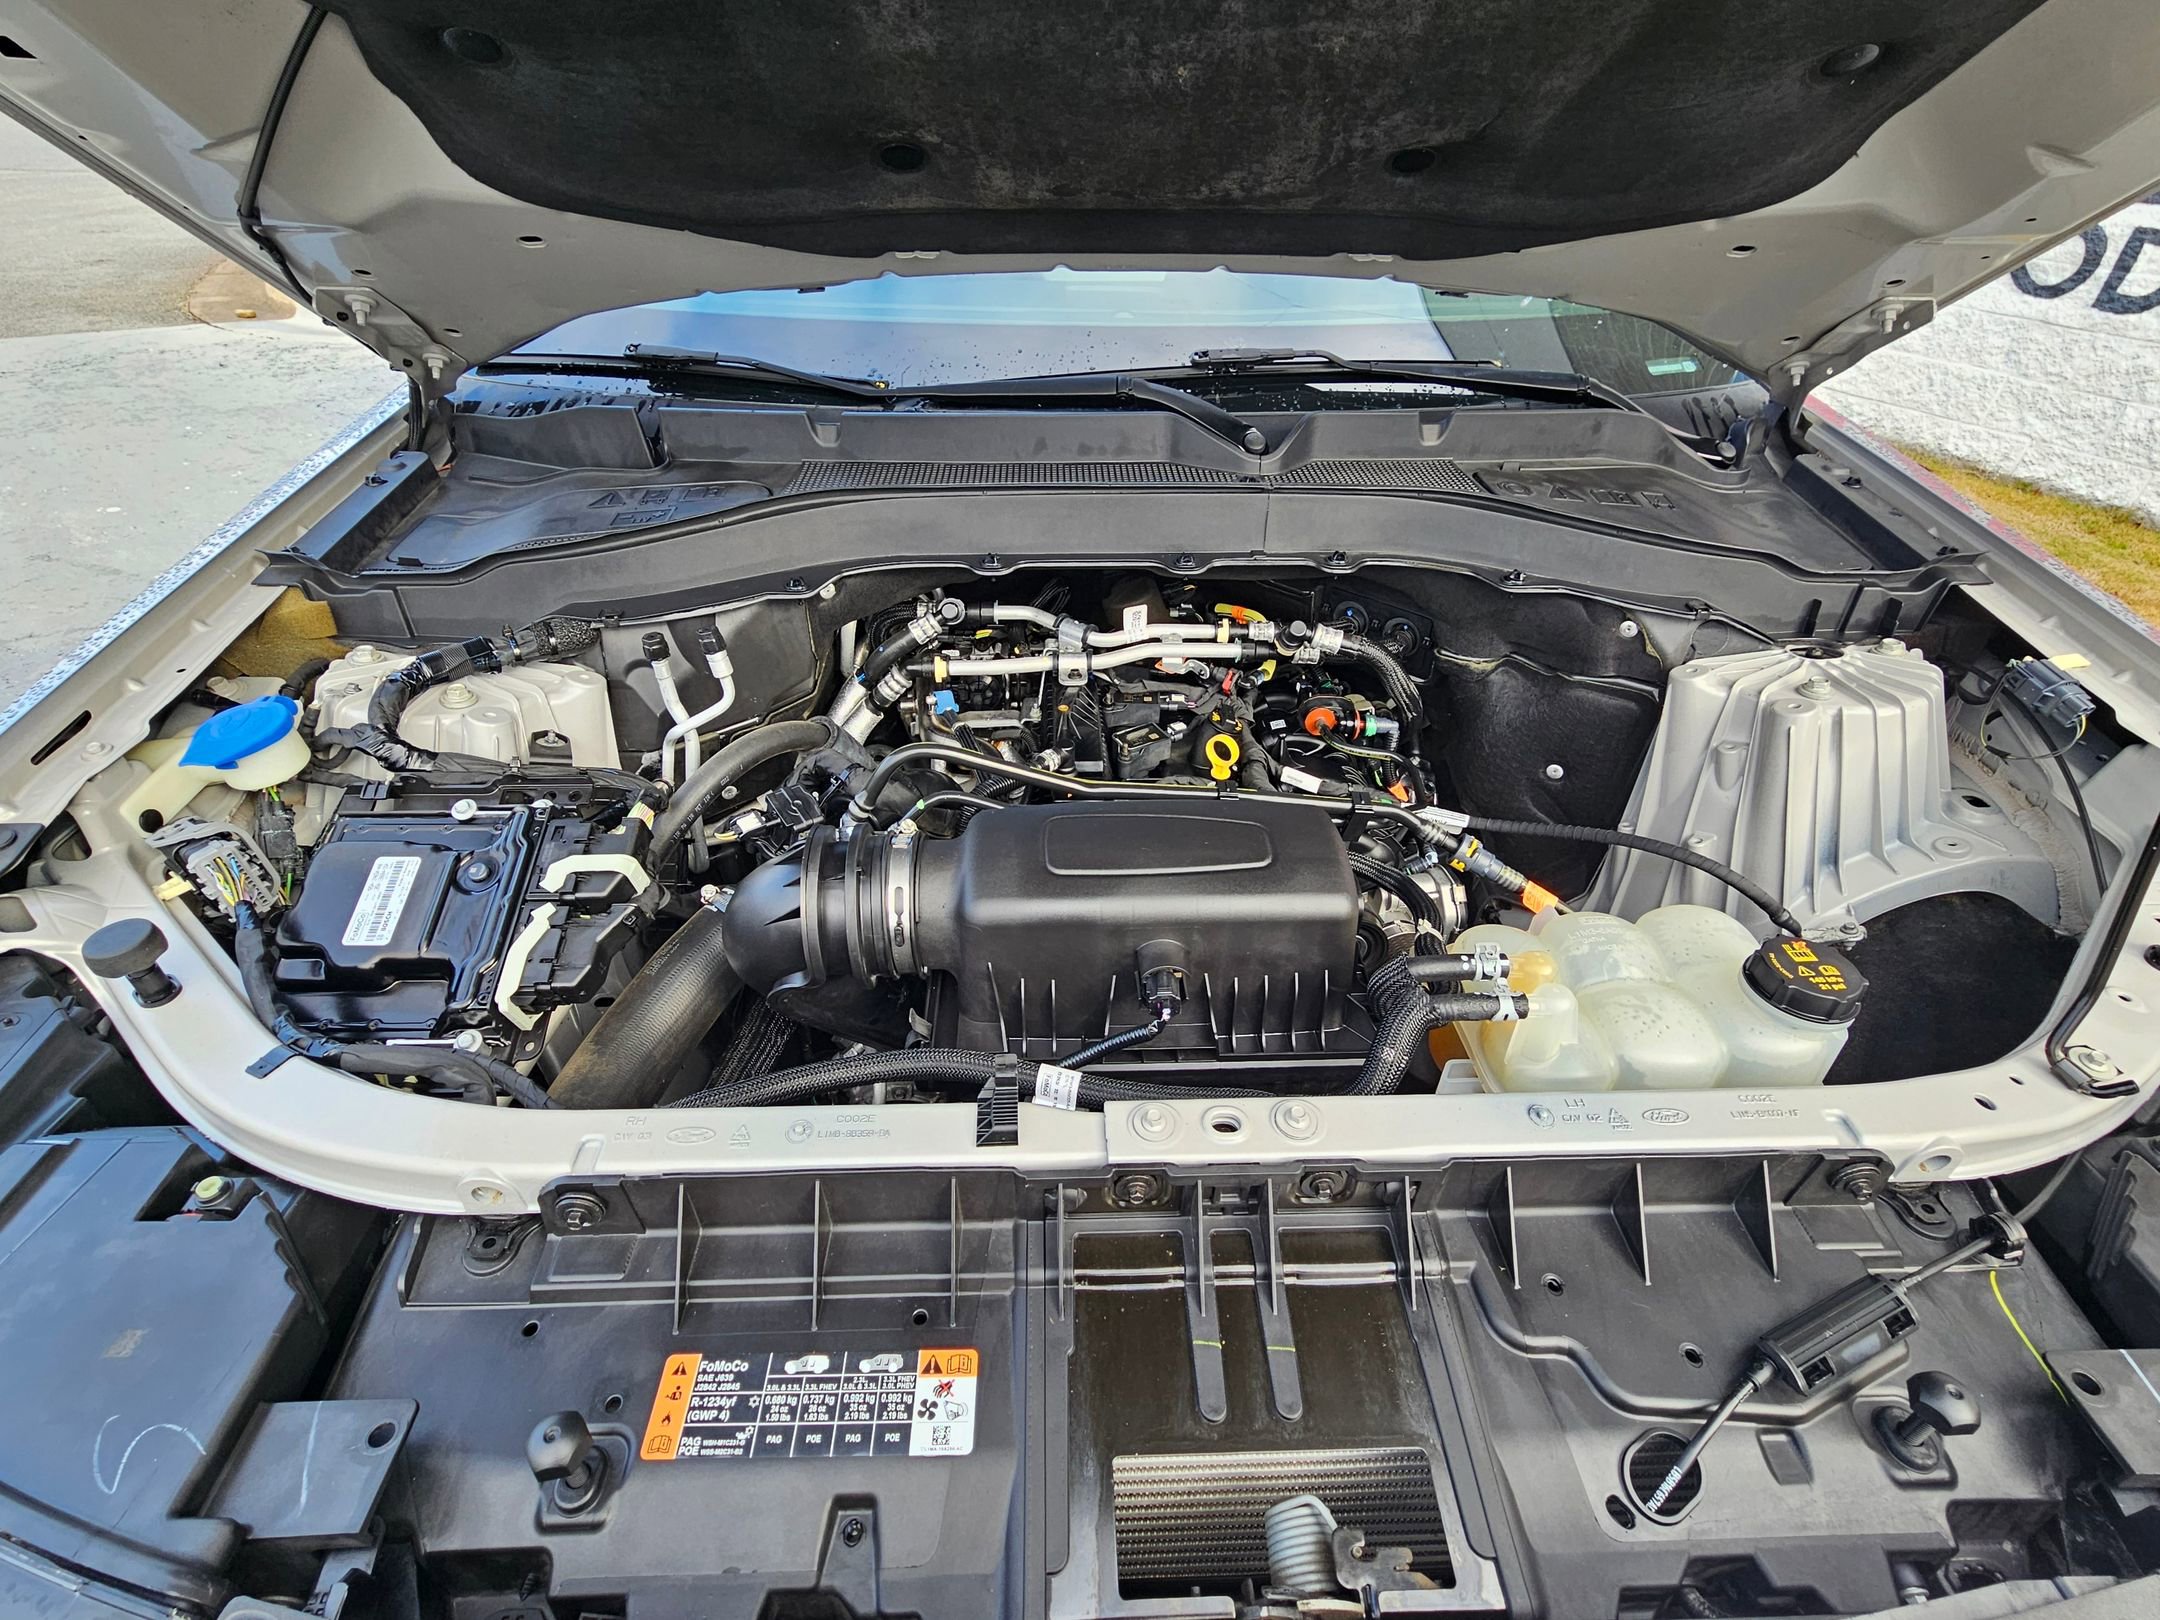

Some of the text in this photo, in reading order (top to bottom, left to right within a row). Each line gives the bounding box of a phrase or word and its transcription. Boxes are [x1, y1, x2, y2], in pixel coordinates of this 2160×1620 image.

[699, 1360, 749, 1373] FoMoCo
[697, 1374, 714, 1382] SAE
[897, 1375, 915, 1383] FHEV
[819, 1383, 838, 1391] FHEV
[690, 1396, 738, 1409] R-1234yf
[787, 1395, 798, 1406] kg
[802, 1395, 835, 1406] 0.737 kg
[843, 1394, 876, 1405] 0.992 kg
[880, 1394, 913, 1405] 0.992 kg
[687, 1410, 730, 1423] (GWP 4)
[779, 1413, 791, 1421] lbs
[818, 1413, 829, 1421] lbs
[844, 1412, 870, 1420] 2.19 lbs
[882, 1412, 908, 1420] 2.19 lbs
[680, 1437, 702, 1447] PAG
[766, 1435, 783, 1444] PAG
[805, 1434, 822, 1443] POE
[845, 1434, 861, 1443] PAG
[884, 1433, 901, 1442] POE
[678, 1446, 700, 1456] POE
